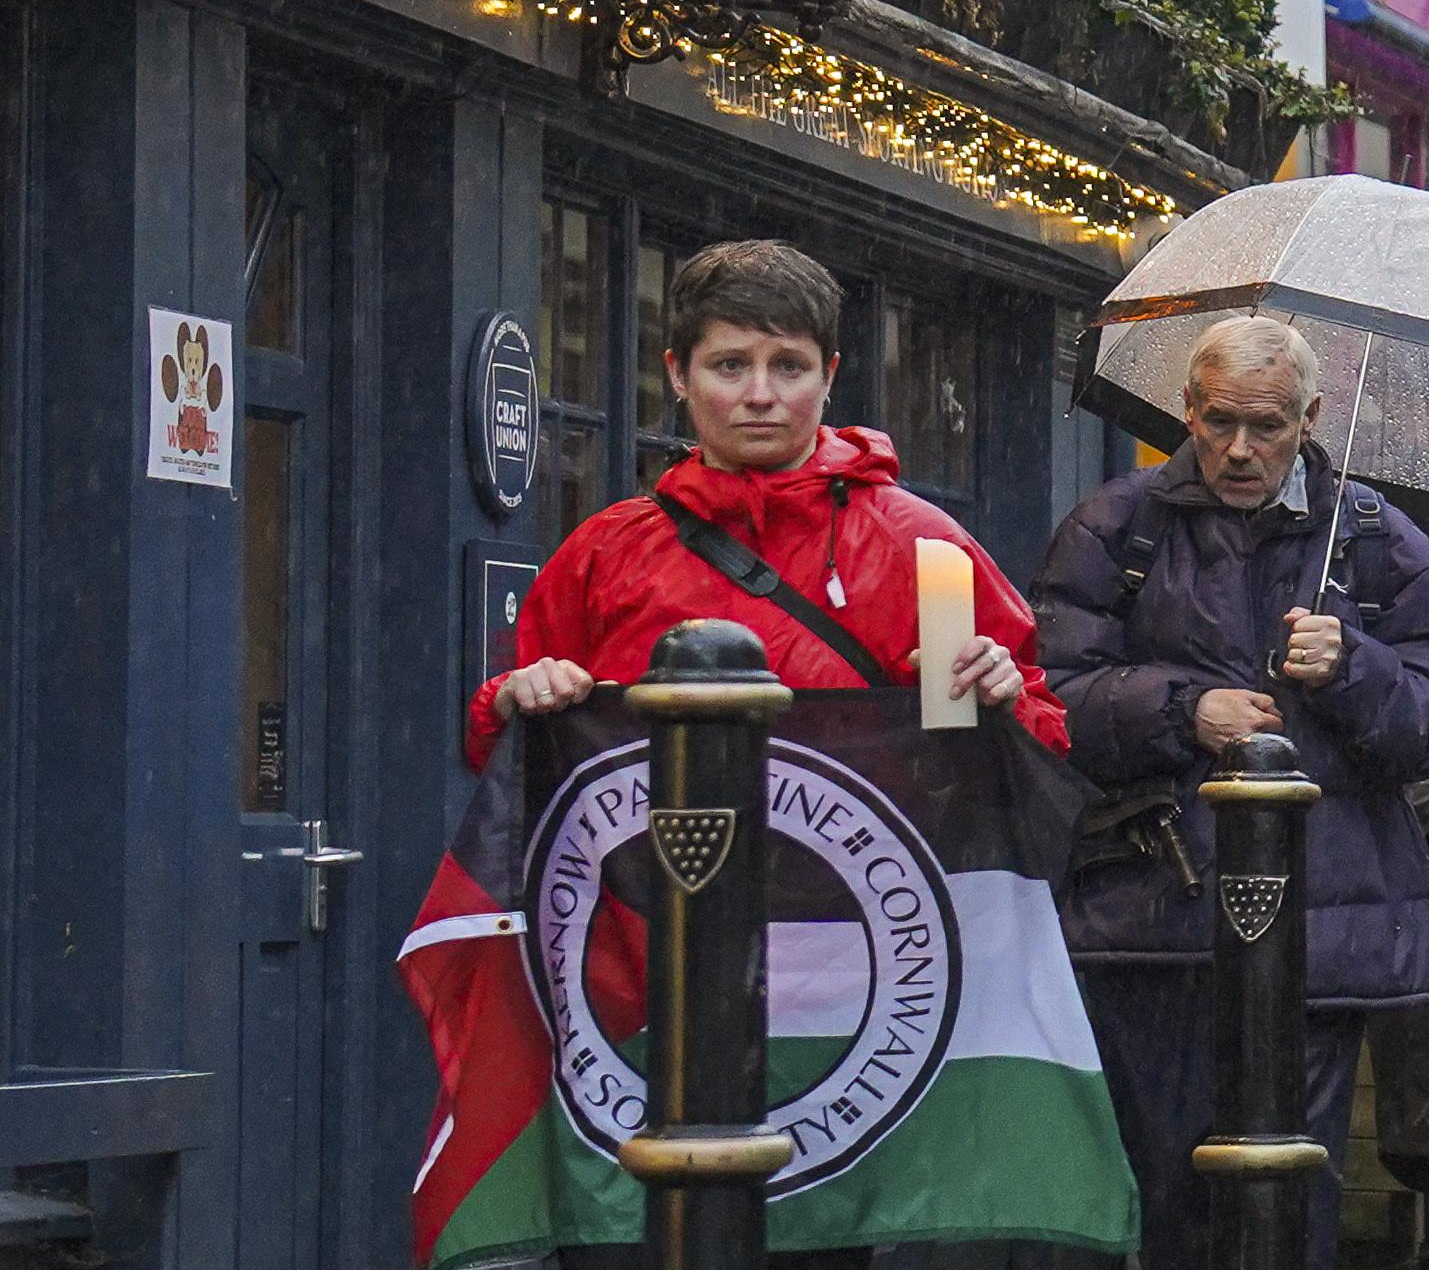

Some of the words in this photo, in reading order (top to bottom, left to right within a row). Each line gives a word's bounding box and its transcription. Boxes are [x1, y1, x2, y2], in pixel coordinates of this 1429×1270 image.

[496, 400, 527, 427] CRAFT
[496, 427, 527, 452] UNION
[861, 855, 933, 1100] CORNWALL
